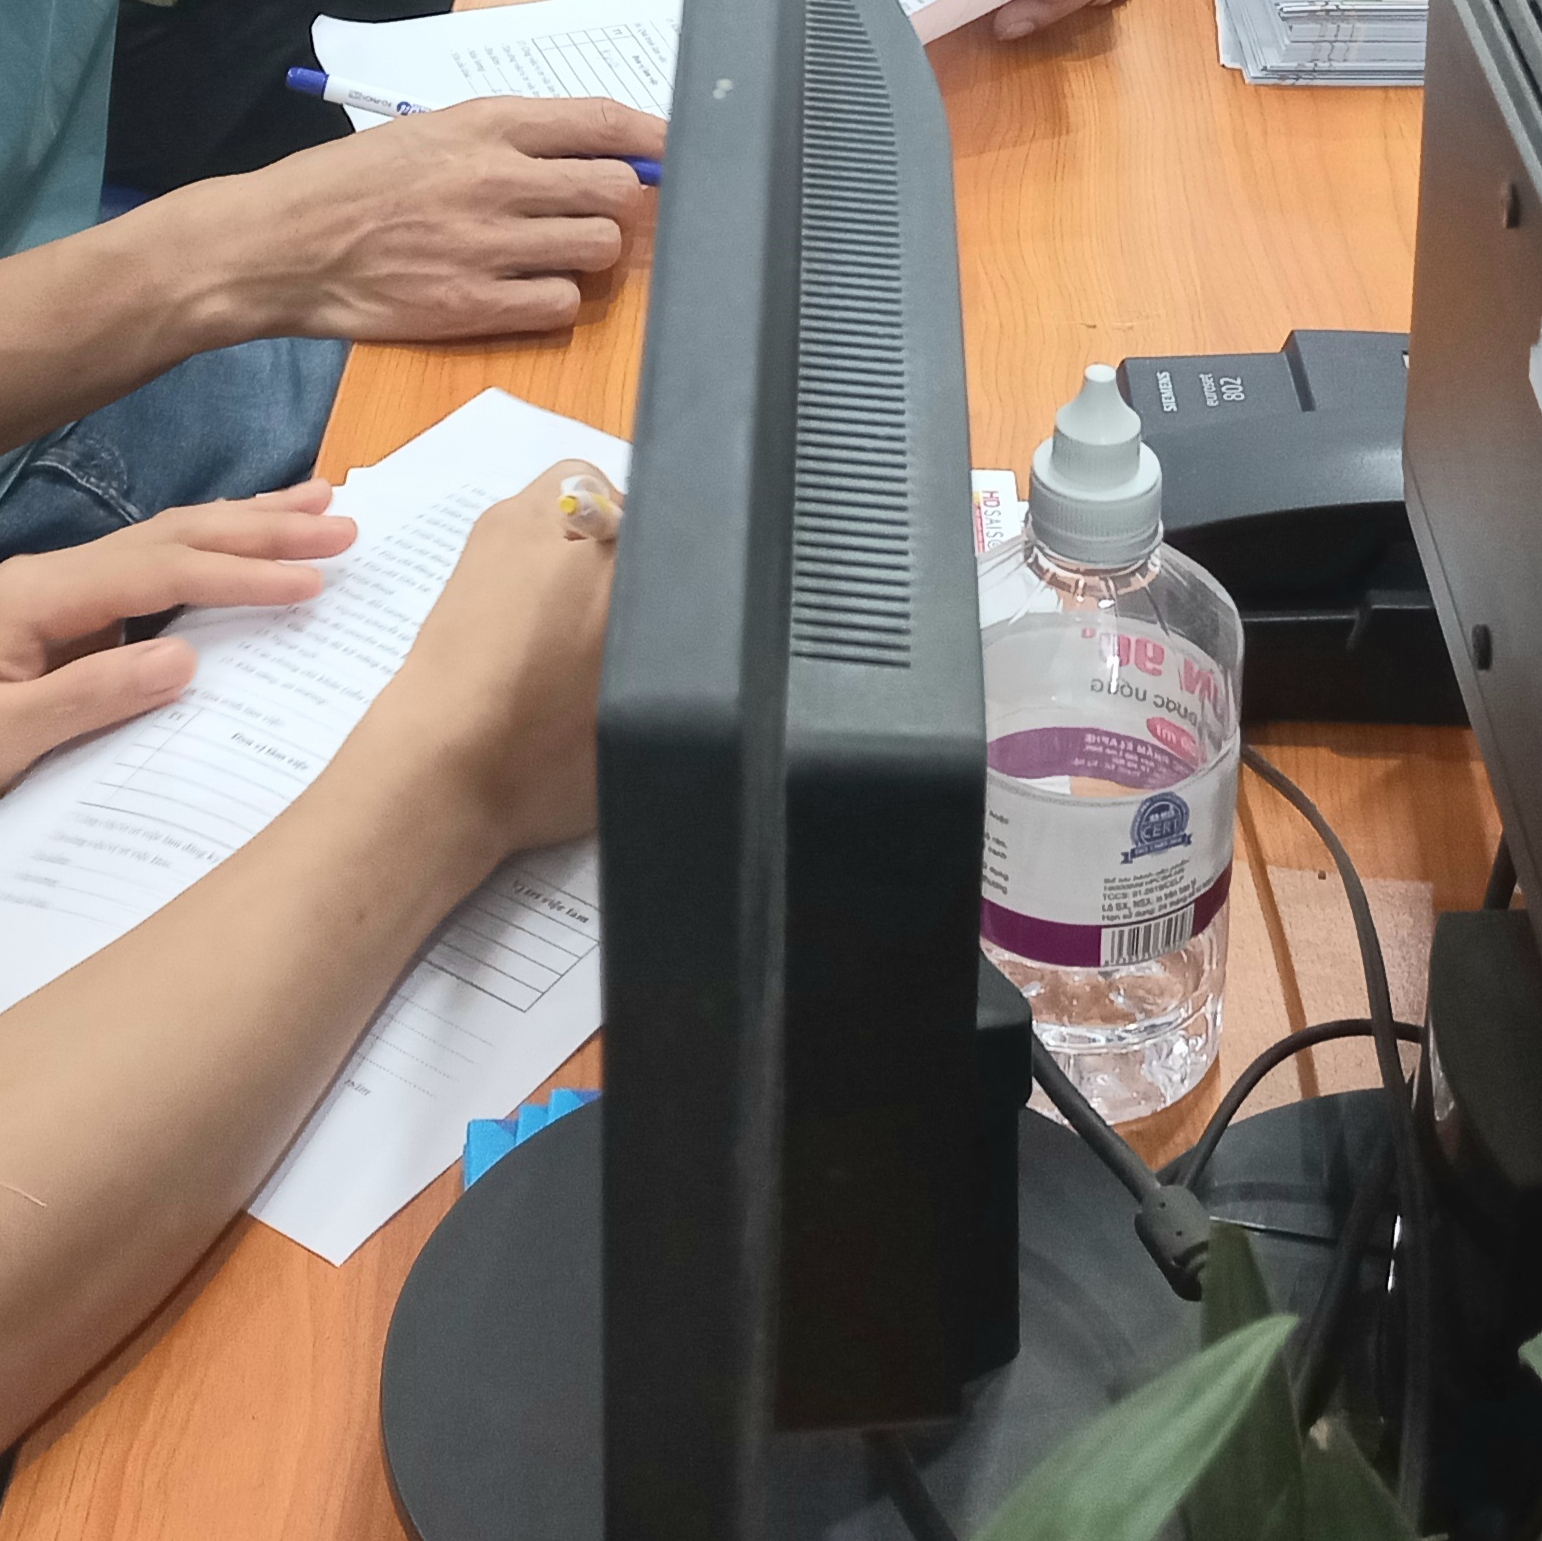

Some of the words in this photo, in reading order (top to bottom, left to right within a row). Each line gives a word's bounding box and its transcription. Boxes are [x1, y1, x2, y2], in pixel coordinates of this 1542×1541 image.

[1156, 371, 1177, 412] SIEMENS
[1199, 373, 1219, 407] euroset
[1219, 377, 1245, 401] 802
[981, 490, 1000, 508] HD
[1142, 819, 1179, 839] CERT
